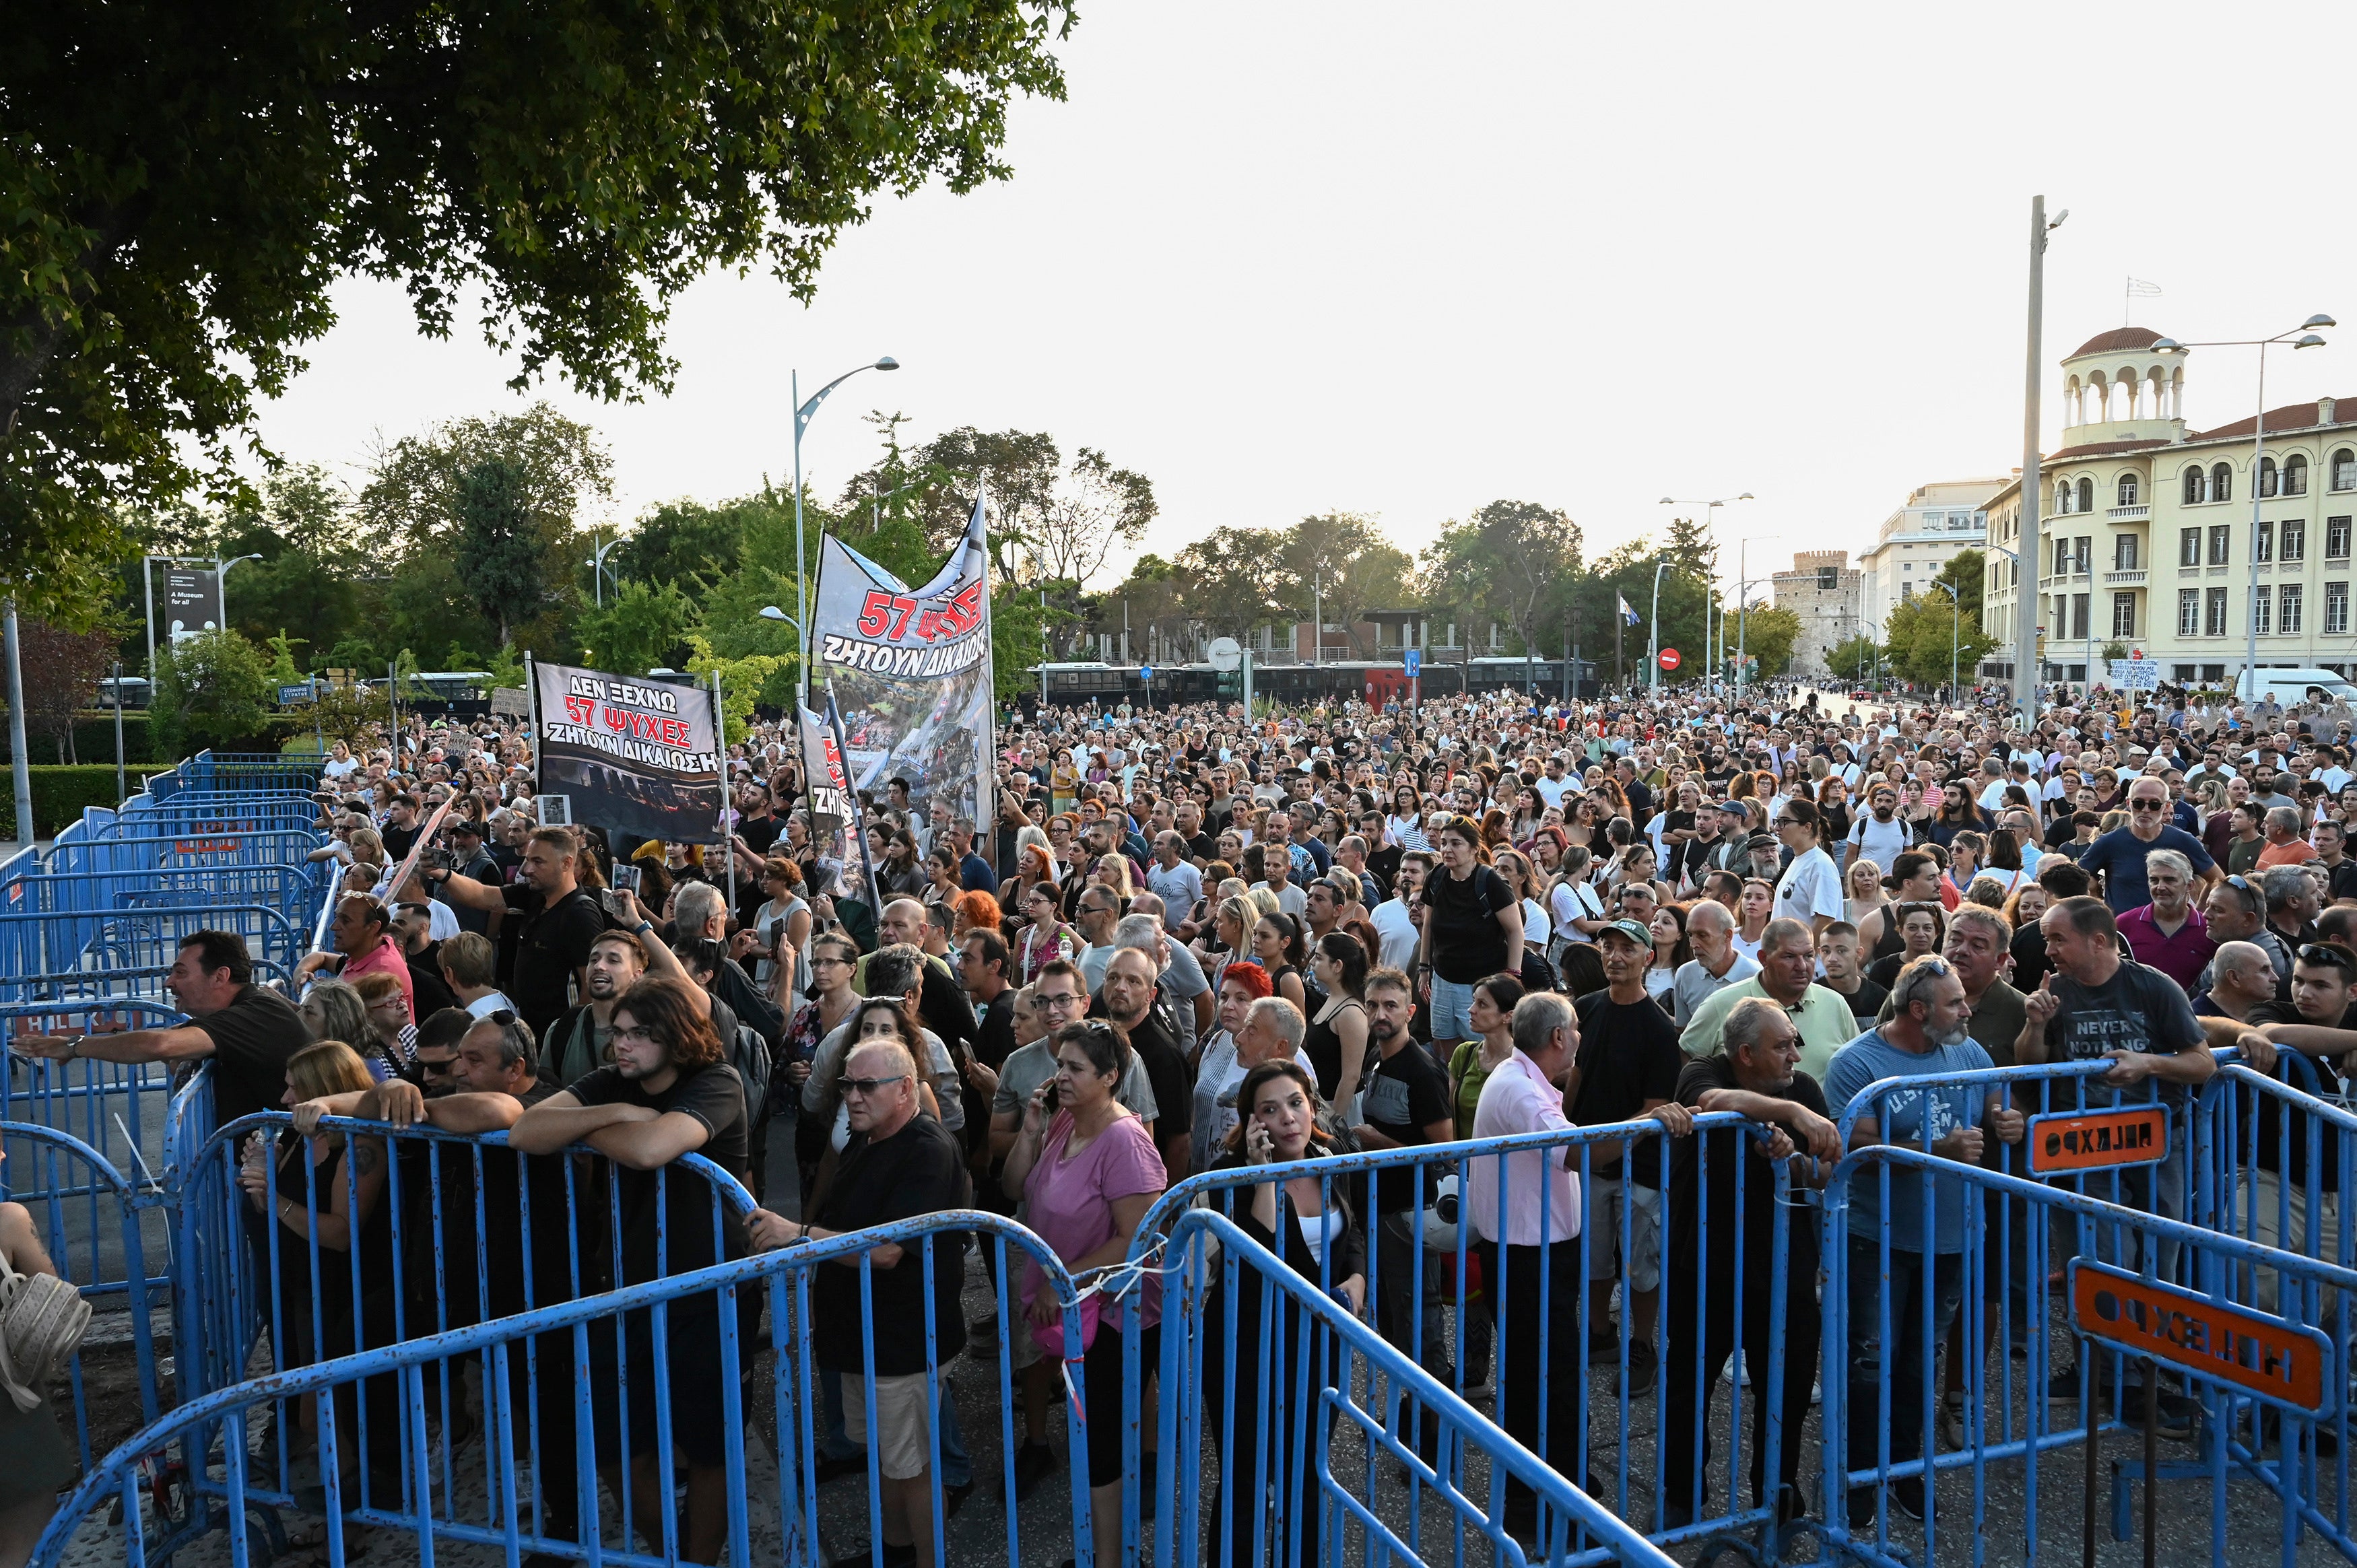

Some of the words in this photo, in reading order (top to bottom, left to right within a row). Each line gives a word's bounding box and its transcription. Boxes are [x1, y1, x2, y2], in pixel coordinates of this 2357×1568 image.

[857, 589, 918, 642] 57
[916, 578, 983, 644] ΨΥΧΕ
[823, 634, 927, 677] ΖΗΤΟΥΝ
[921, 623, 986, 677] ΔΙΚΑΙΩ
[570, 675, 607, 700] ΔΕΝ
[609, 682, 677, 714] ΞΕΧΝΩ
[449, 738, 470, 746] ΜΑΦΙΑ
[563, 693, 595, 728] 57
[603, 706, 692, 750] ΨΥΧΕΣ
[548, 722, 621, 757] ΖΗΤΟΥΝ
[623, 740, 719, 774] ΔΙΚΑΙΩΣΗ
[2070, 1038, 2147, 1053] NOTHNG
[2077, 1020, 2133, 1035] NEVER
